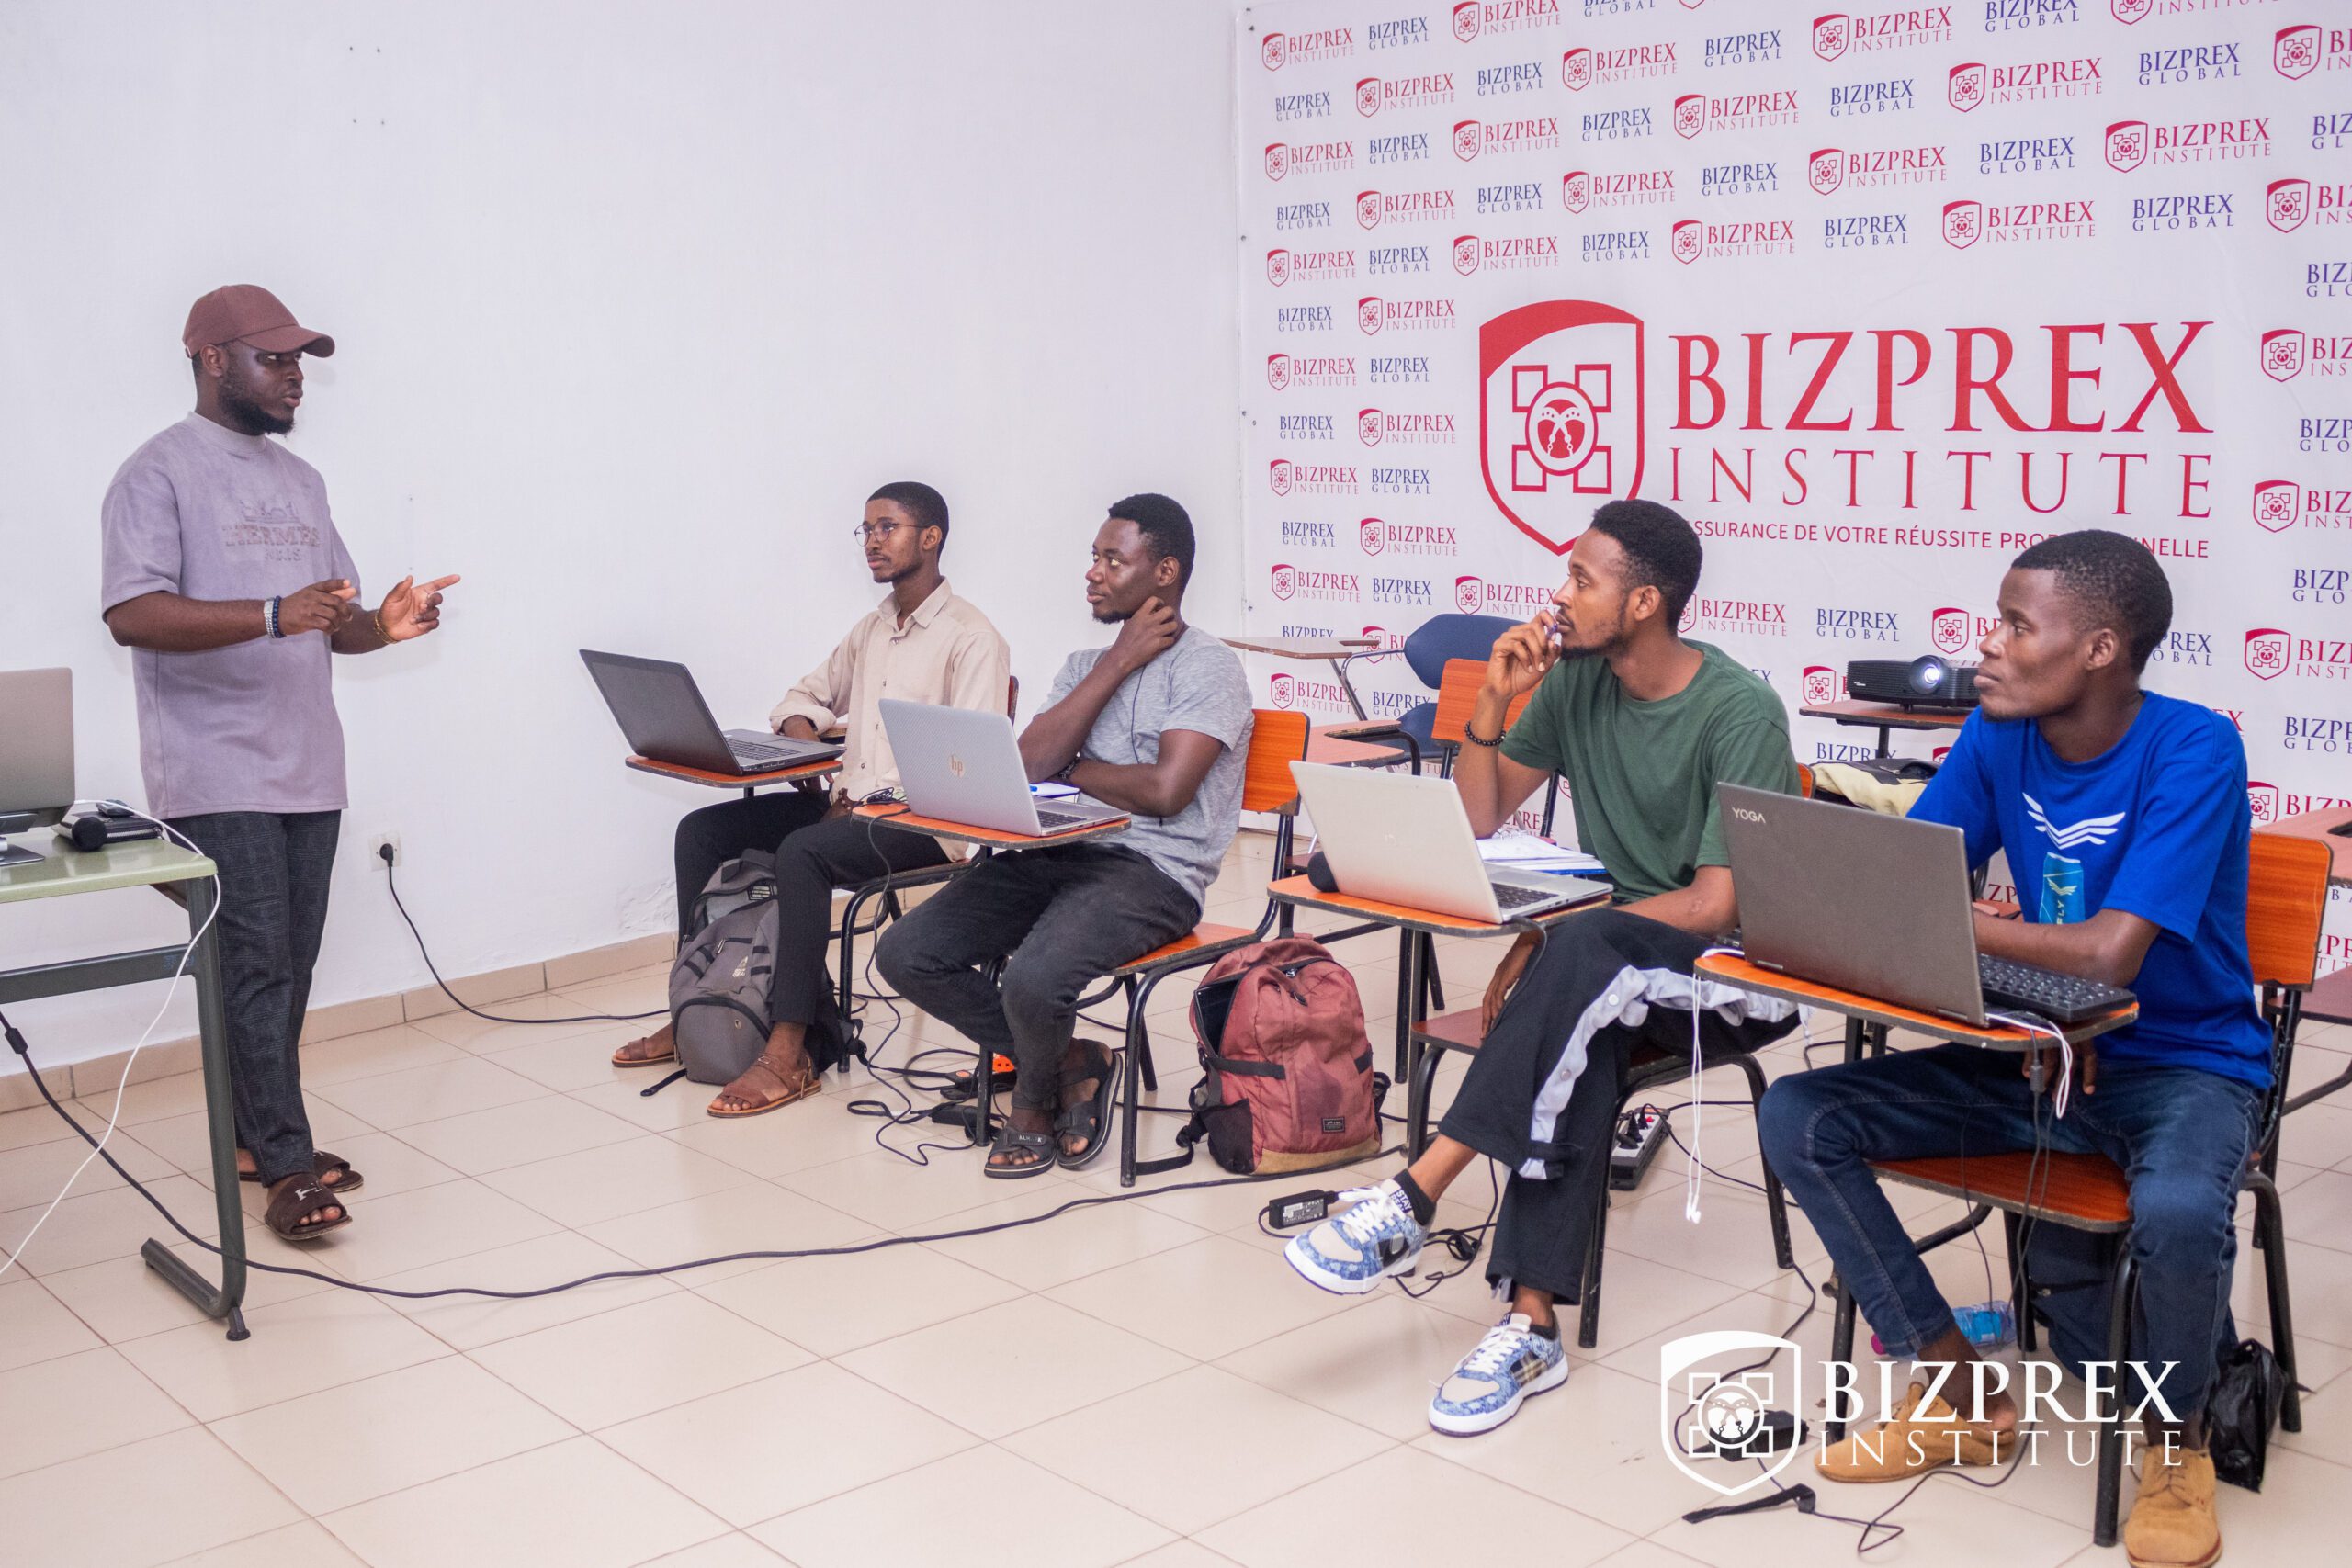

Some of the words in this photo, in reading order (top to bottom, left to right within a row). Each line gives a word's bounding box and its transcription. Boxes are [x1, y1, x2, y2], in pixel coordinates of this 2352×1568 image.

[1584, 0, 1656, 17] GLOBAL
[1369, 17, 1428, 40] BIZPREX
[1484, 14, 1561, 36] INSTITUTE
[1855, 6, 1952, 39] BIZPREX
[1984, 9, 2080, 33] GLOBAL
[1289, 27, 1353, 54] BIZPREX
[1369, 32, 1429, 51] GLOBAL
[1705, 29, 1781, 57] BIZPREX
[1853, 28, 1952, 53] INSTITUTE
[1289, 45, 1353, 65] INSTITUTE
[1596, 42, 1677, 72] BIZPREX
[1704, 48, 1782, 68] GLOBAL
[2139, 42, 2241, 73] BIZPREX
[1478, 62, 1543, 86] BIZPREX
[1596, 62, 1677, 85] INSTITUTE
[1992, 57, 2102, 90] BIZPREX
[2138, 63, 2242, 86] GLOBAL
[1385, 73, 1454, 99] BIZPREX
[1477, 79, 1544, 96] GLOBAL
[1831, 78, 1914, 106] BIZPREX
[1991, 81, 2102, 104] INSTITUTE
[1275, 91, 1330, 113] BIZPREX
[1385, 92, 1454, 111] INSTITUTE
[1711, 90, 1799, 118] BIZPREX
[1830, 97, 1915, 118] GLOBAL
[1276, 107, 1331, 122] GLOBAL
[1582, 107, 1652, 131] BIZPREX
[1709, 112, 1799, 132] INSTITUTE
[1485, 118, 1559, 143] BIZPREX
[1582, 125, 1653, 142] GLOBAL
[2154, 118, 2271, 150] BIZPREX
[1291, 141, 1354, 164] BIZPREX
[1370, 133, 1428, 155] BIZPREX
[1485, 136, 1560, 155] INSTITUTE
[1980, 136, 2075, 163] BIZPREX
[2154, 142, 2271, 165] INSTITUTE
[1369, 149, 1430, 164] GLOBAL
[1849, 146, 1946, 175] BIZPREX
[1980, 156, 2075, 175] GLOBAL
[1291, 159, 1354, 175] INSTITUTE
[1702, 163, 1778, 186] BIZPREX
[1594, 170, 1675, 195] BIZPREX
[1702, 180, 1779, 197] GLOBAL
[1848, 169, 1947, 188] INSTITUTE
[1385, 190, 1454, 213] BIZPREX
[1478, 183, 1543, 204] BIZPREX
[1593, 191, 1675, 208] INSTITUTE
[1277, 202, 1330, 221] BIZPREX
[1385, 209, 1455, 224] INSTITUTE
[1477, 199, 1544, 214] GLOBAL
[1988, 200, 2095, 228] BIZPREX
[2133, 193, 2233, 220] BIZPREX
[1277, 218, 1331, 231] GLOBAL
[1707, 220, 1794, 245] BIZPREX
[1825, 214, 1907, 237] BIZPREX
[1986, 223, 2096, 243] INSTITUTE
[2132, 214, 2234, 232] GLOBAL
[1484, 236, 1558, 258] BIZPREX
[1582, 231, 1649, 252] BIZPREX
[1704, 242, 1794, 258] INSTITUTE
[1825, 232, 1909, 249] GLOBAL
[1294, 250, 1356, 271] BIZPREX
[1369, 246, 1429, 265] BIZPREX
[1484, 255, 1559, 271] INSTITUTE
[1582, 248, 1650, 263] GLOBAL
[1293, 268, 1356, 282] INSTITUTE
[1369, 262, 1430, 275] GLOBAL
[1278, 306, 1332, 323] BIZPREX
[1386, 299, 1455, 320] BIZPREX
[1278, 321, 1333, 333] GLOBAL
[1386, 318, 1456, 331] INSTITUTE
[1294, 357, 1355, 376] BIZPREX
[1371, 357, 1429, 374] BIZPREX
[1294, 375, 1357, 387] INSTITUTE
[1370, 373, 1430, 384] GLOBAL
[1669, 321, 2214, 433] BIZPREX
[1280, 415, 1334, 431] BIZPREX
[1386, 414, 1455, 432] BIZPREX
[1280, 431, 1335, 440] GLOBAL
[1385, 433, 1456, 444] INSTITUTE
[1295, 466, 1358, 483] BIZPREX
[1372, 468, 1430, 485] BIZPREX
[1669, 446, 2212, 518] INSTITUTE
[1295, 482, 1359, 495] INSTITUTE
[1372, 484, 1431, 495] GLOBAL
[1283, 522, 1335, 538] BIZPREX
[1388, 525, 1456, 545] BIZPREX
[1691, 520, 1788, 539] SSURANCE
[1794, 525, 1817, 541] DE
[1824, 525, 1889, 544] VOTRE
[1895, 524, 1992, 548] RÉUSSITE
[1283, 536, 1336, 547] GLOBAL
[1387, 543, 1457, 557] INSTITUTE
[1297, 571, 1360, 592] BIZPREX
[1373, 578, 1431, 596] BIZPREX
[1296, 589, 1361, 603] INSTITUTE
[1373, 592, 1433, 606] GLOBAL
[1487, 584, 1555, 604] BIZPREX
[1702, 599, 1786, 624] BIZPREX
[1817, 608, 1899, 631] BIZPREX
[1700, 619, 1787, 637] INSTITUTE
[1816, 626, 1900, 643] GLOBAL
[1297, 697, 1355, 715] INSTITUT
[1731, 807, 1766, 824] YOGA
